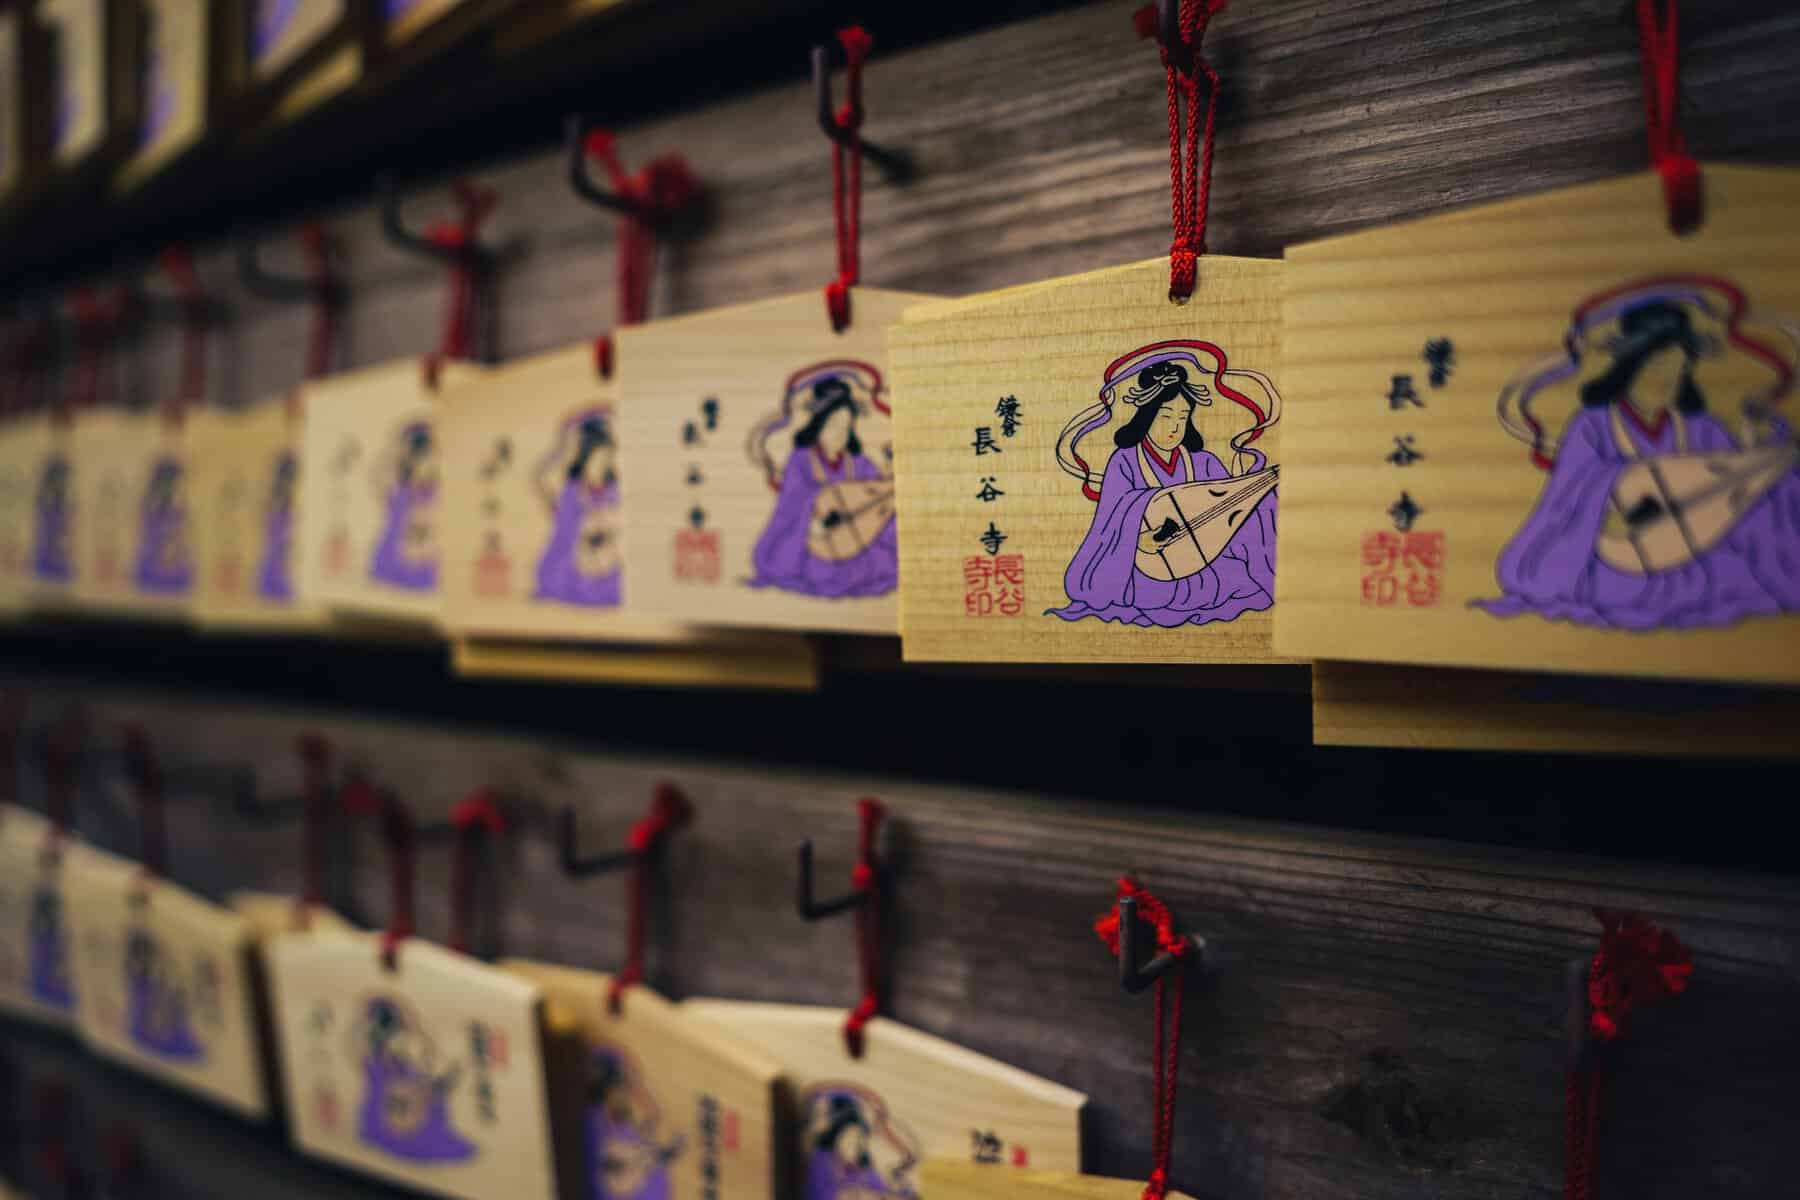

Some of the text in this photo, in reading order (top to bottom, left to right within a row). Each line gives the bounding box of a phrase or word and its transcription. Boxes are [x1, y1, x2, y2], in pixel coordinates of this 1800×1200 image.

[971, 426, 1008, 555] 長谷寺
[994, 554, 1024, 617] 長谷
